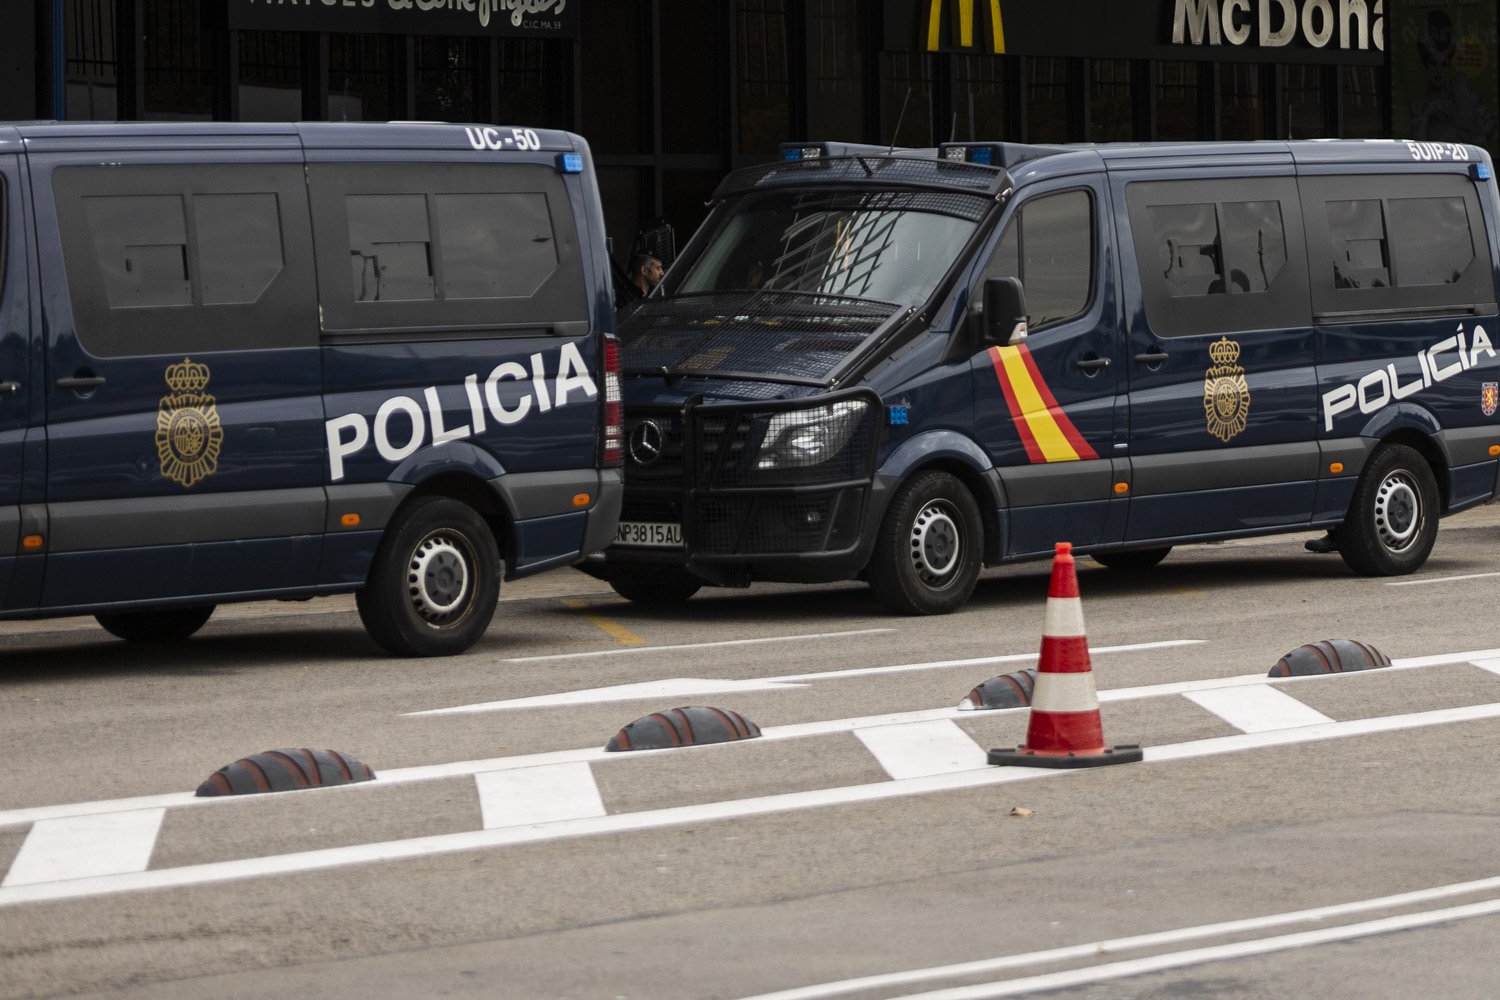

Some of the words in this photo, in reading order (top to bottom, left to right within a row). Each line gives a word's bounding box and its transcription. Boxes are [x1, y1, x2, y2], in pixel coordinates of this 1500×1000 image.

[1406, 142, 1469, 161] 5UIP-20
[325, 342, 598, 481] POLICIA
[1322, 322, 1497, 432] POLICÍA
